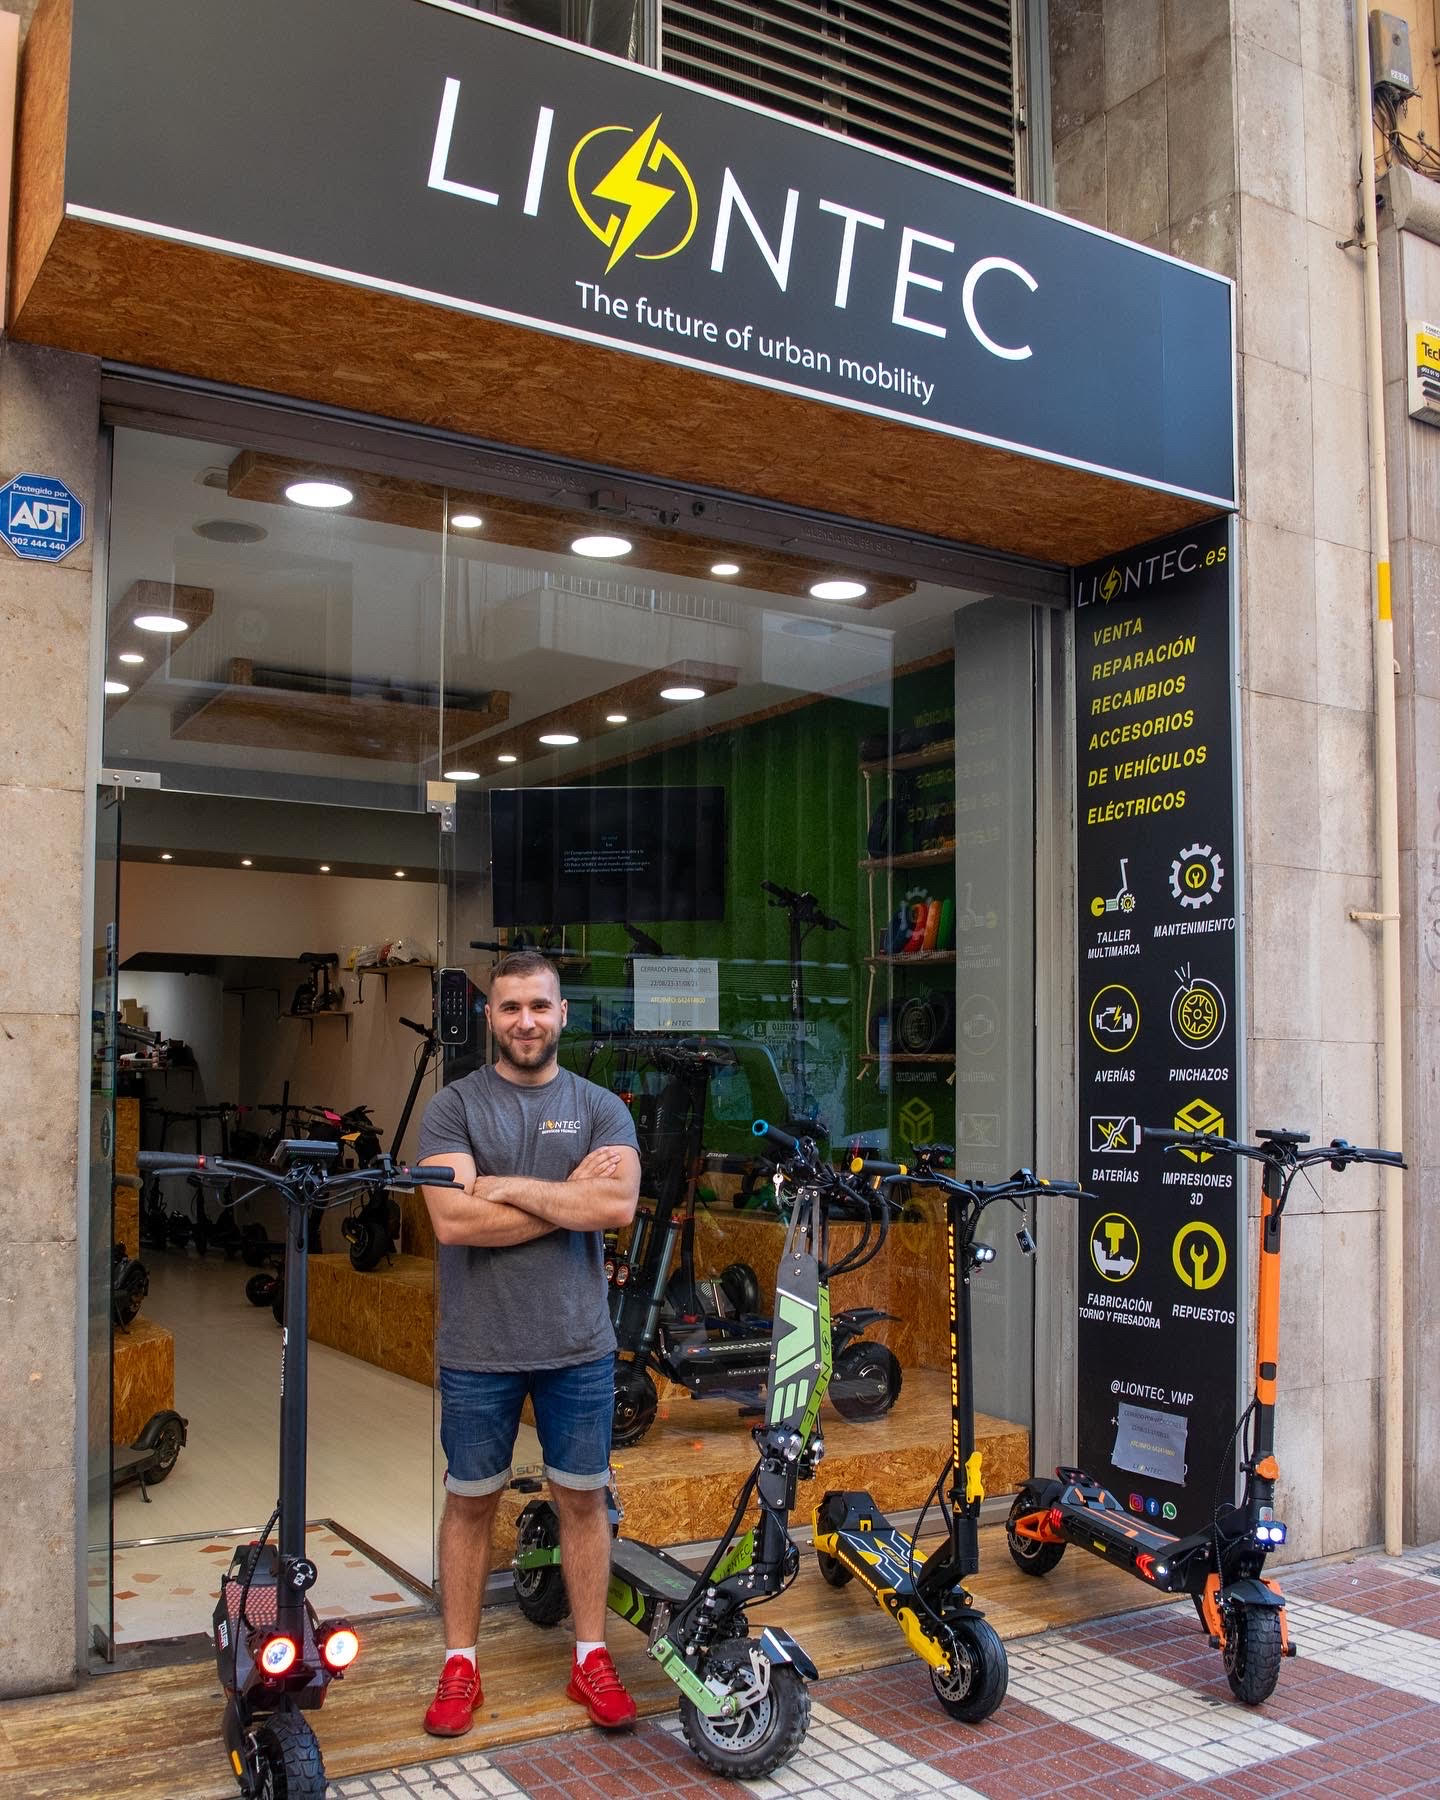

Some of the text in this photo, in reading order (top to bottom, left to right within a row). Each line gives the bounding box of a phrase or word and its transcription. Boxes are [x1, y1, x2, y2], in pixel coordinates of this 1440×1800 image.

[427, 77, 1039, 361] LIONTEC
[575, 280, 935, 406] The future of urban mobility
[13, 483, 68, 498] Protegido por
[10, 501, 69, 533] ADT
[12, 536, 28, 546] 902
[31, 538, 47, 548] 444
[49, 541, 66, 551] 440
[1093, 617, 1143, 647] VENTA
[1092, 634, 1196, 681] REPARACIÓN
[1091, 675, 1186, 716] RECAMBIOS
[1089, 709, 1194, 751] ACCESORIOS
[1088, 745, 1207, 787] DE VEHÍCULOS
[1087, 789, 1186, 825] ELÉCTRICOS
[1097, 929, 1131, 944] TALLER
[1153, 917, 1235, 938] MANTENIMIENTO
[1088, 944, 1140, 959] MULTIMARCA
[1094, 1067, 1136, 1083] AVERÍAS
[1169, 1068, 1229, 1082] PINCHAZOS
[1091, 1167, 1139, 1183] BATERÍAS
[1162, 1172, 1233, 1188] IMPRESIONES
[1189, 1192, 1204, 1205] 3D
[1087, 1293, 1152, 1313] FABRICACIÓN
[1079, 1307, 1161, 1330] TORNO Y FRESADORA
[1172, 1304, 1235, 1325] REPUESTOS
[1110, 1379, 1194, 1406] @LIONTEC_VMP
